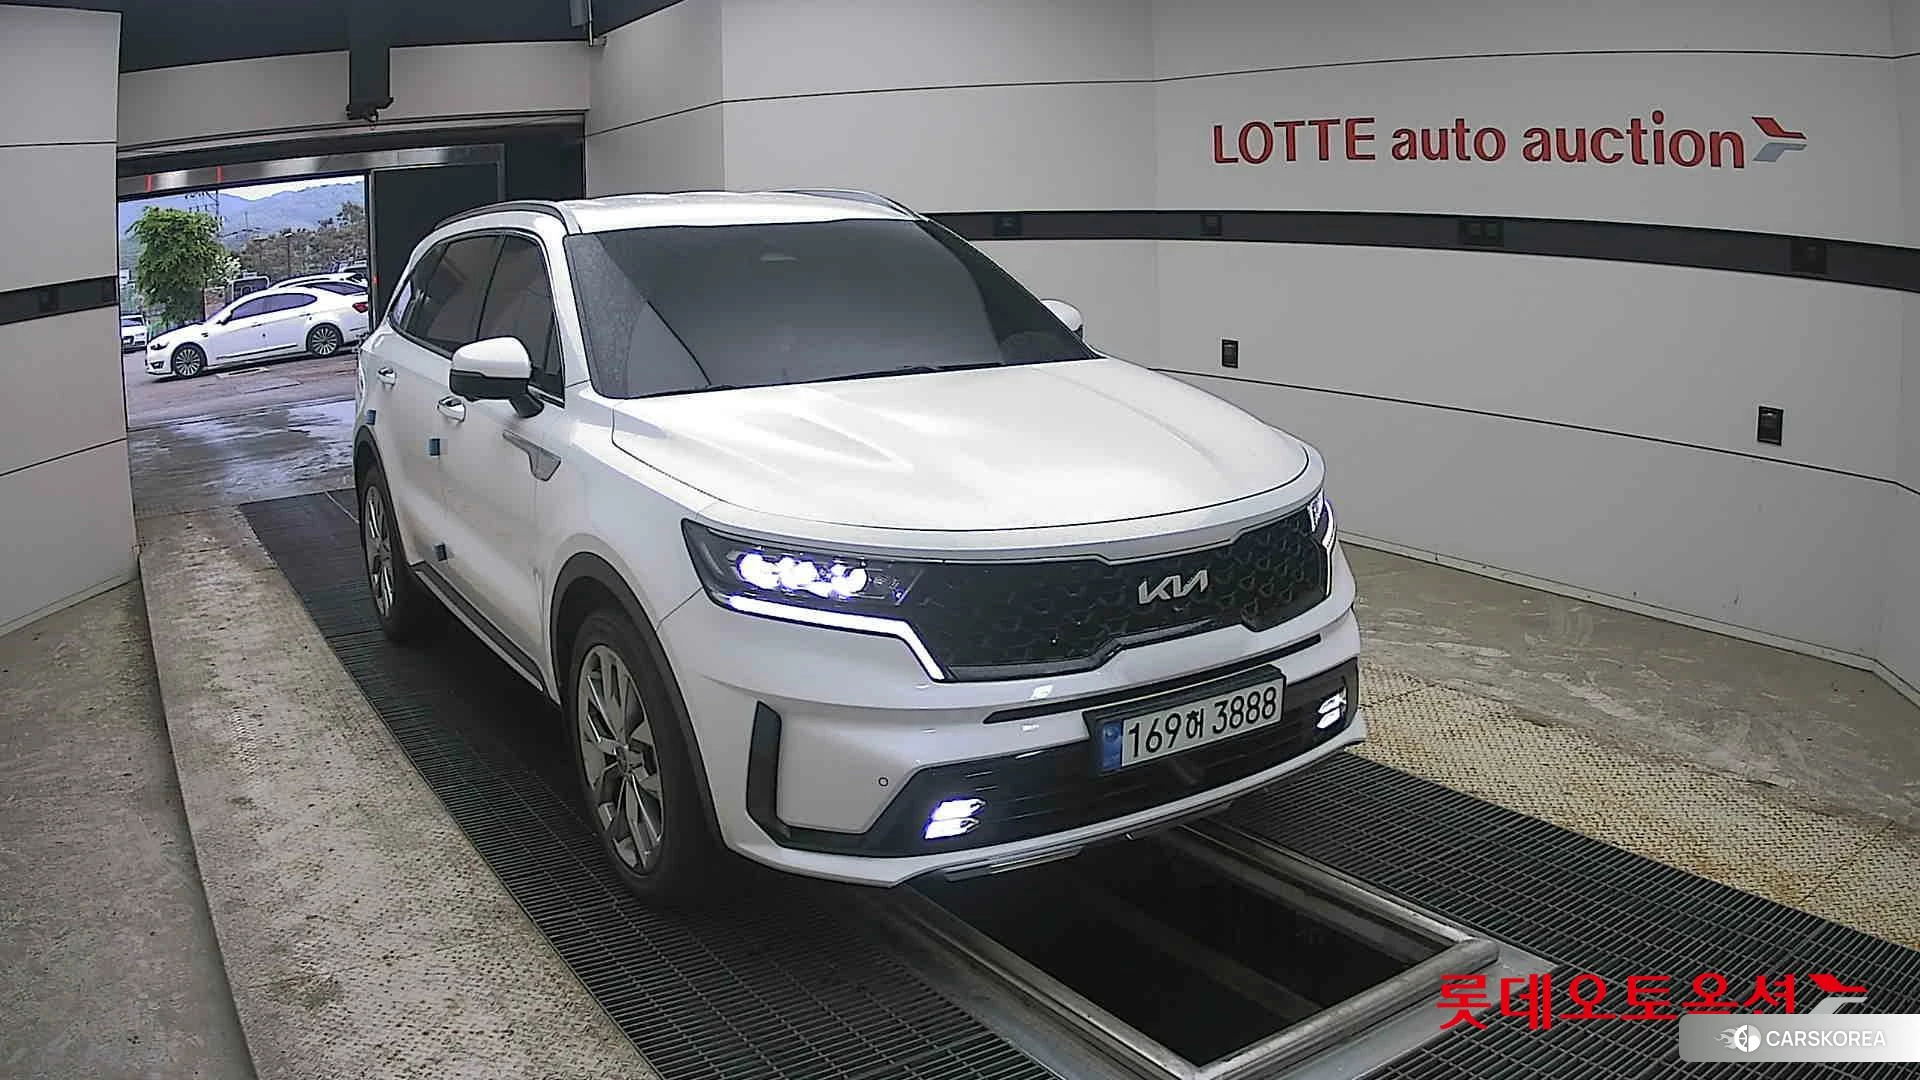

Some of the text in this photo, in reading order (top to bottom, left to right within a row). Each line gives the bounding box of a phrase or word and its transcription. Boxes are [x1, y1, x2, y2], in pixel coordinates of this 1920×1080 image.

[1212, 110, 1746, 169] LOTTE auto auction
[1138, 569, 1209, 605] KIA
[1128, 686, 1277, 758] 169허 3888
